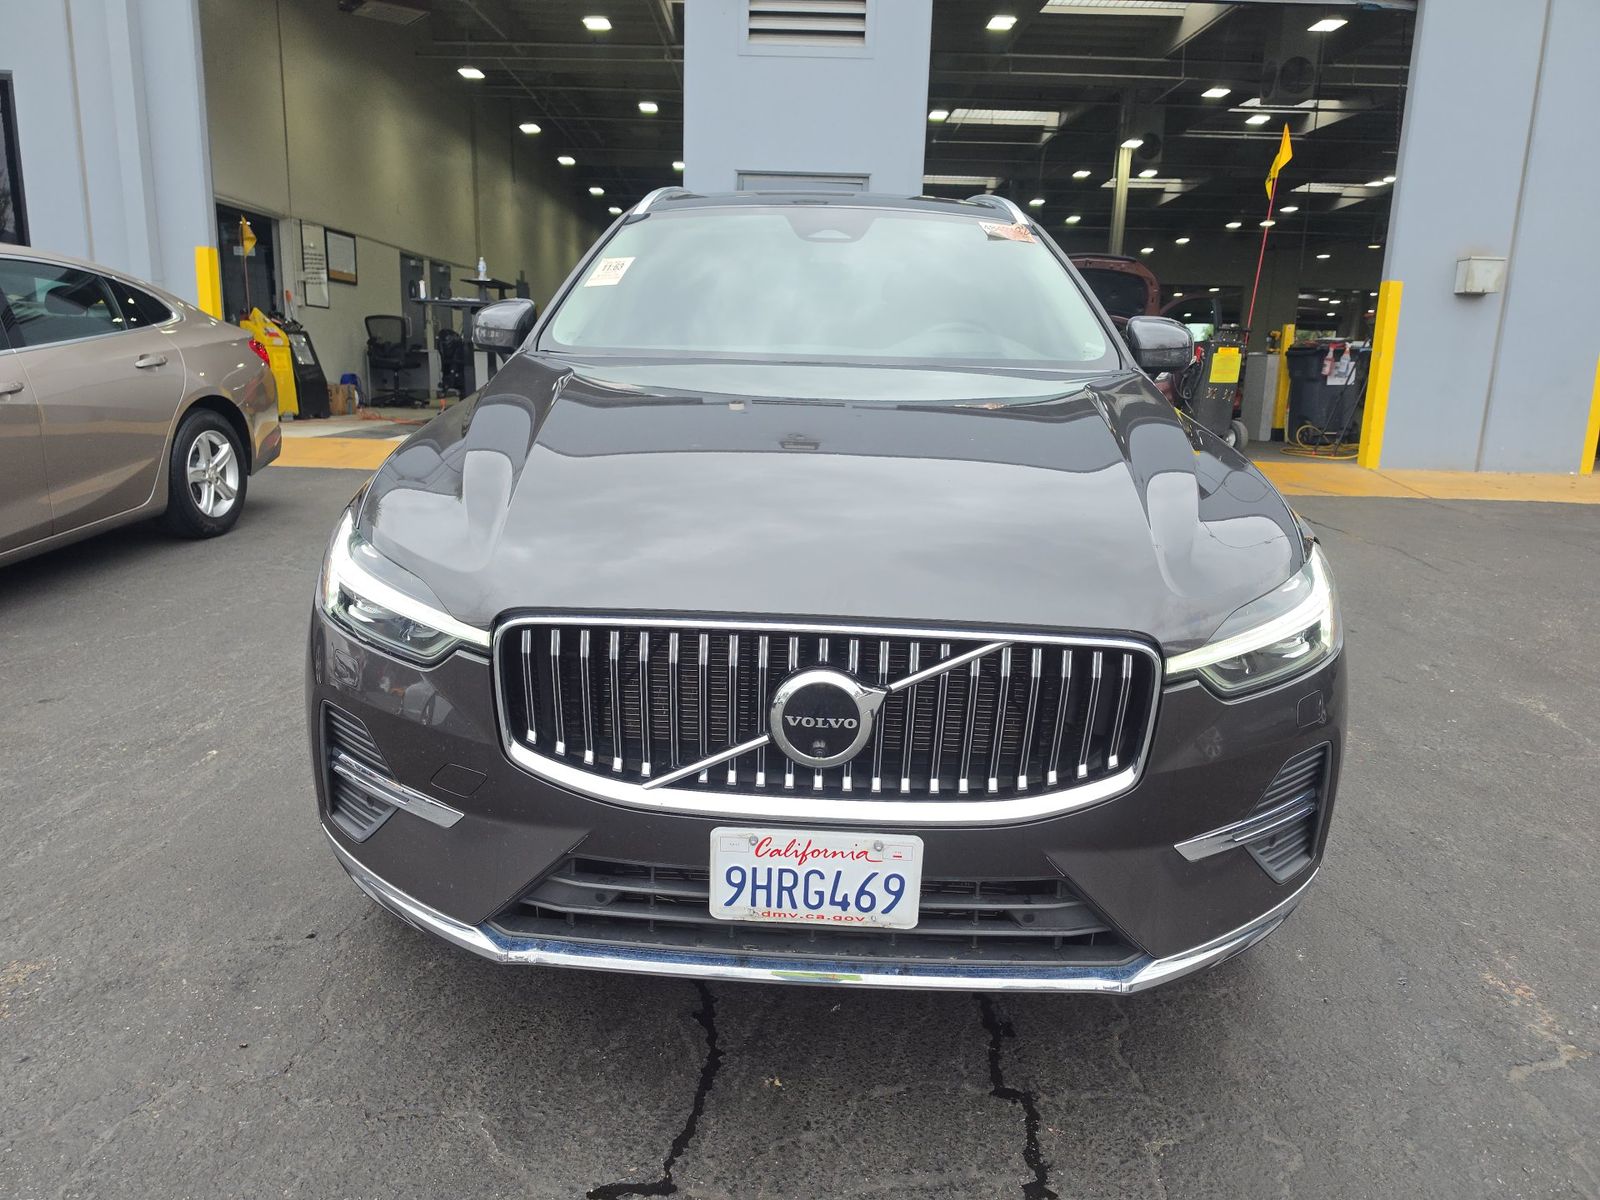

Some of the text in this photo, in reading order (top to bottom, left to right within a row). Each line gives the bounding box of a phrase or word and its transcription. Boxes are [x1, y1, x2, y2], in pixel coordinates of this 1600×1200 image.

[785, 715, 858, 729] VOLVO
[754, 836, 883, 866] California
[723, 866, 906, 915] 9HRG469
[761, 910, 866, 923] dmv.ca.gov
